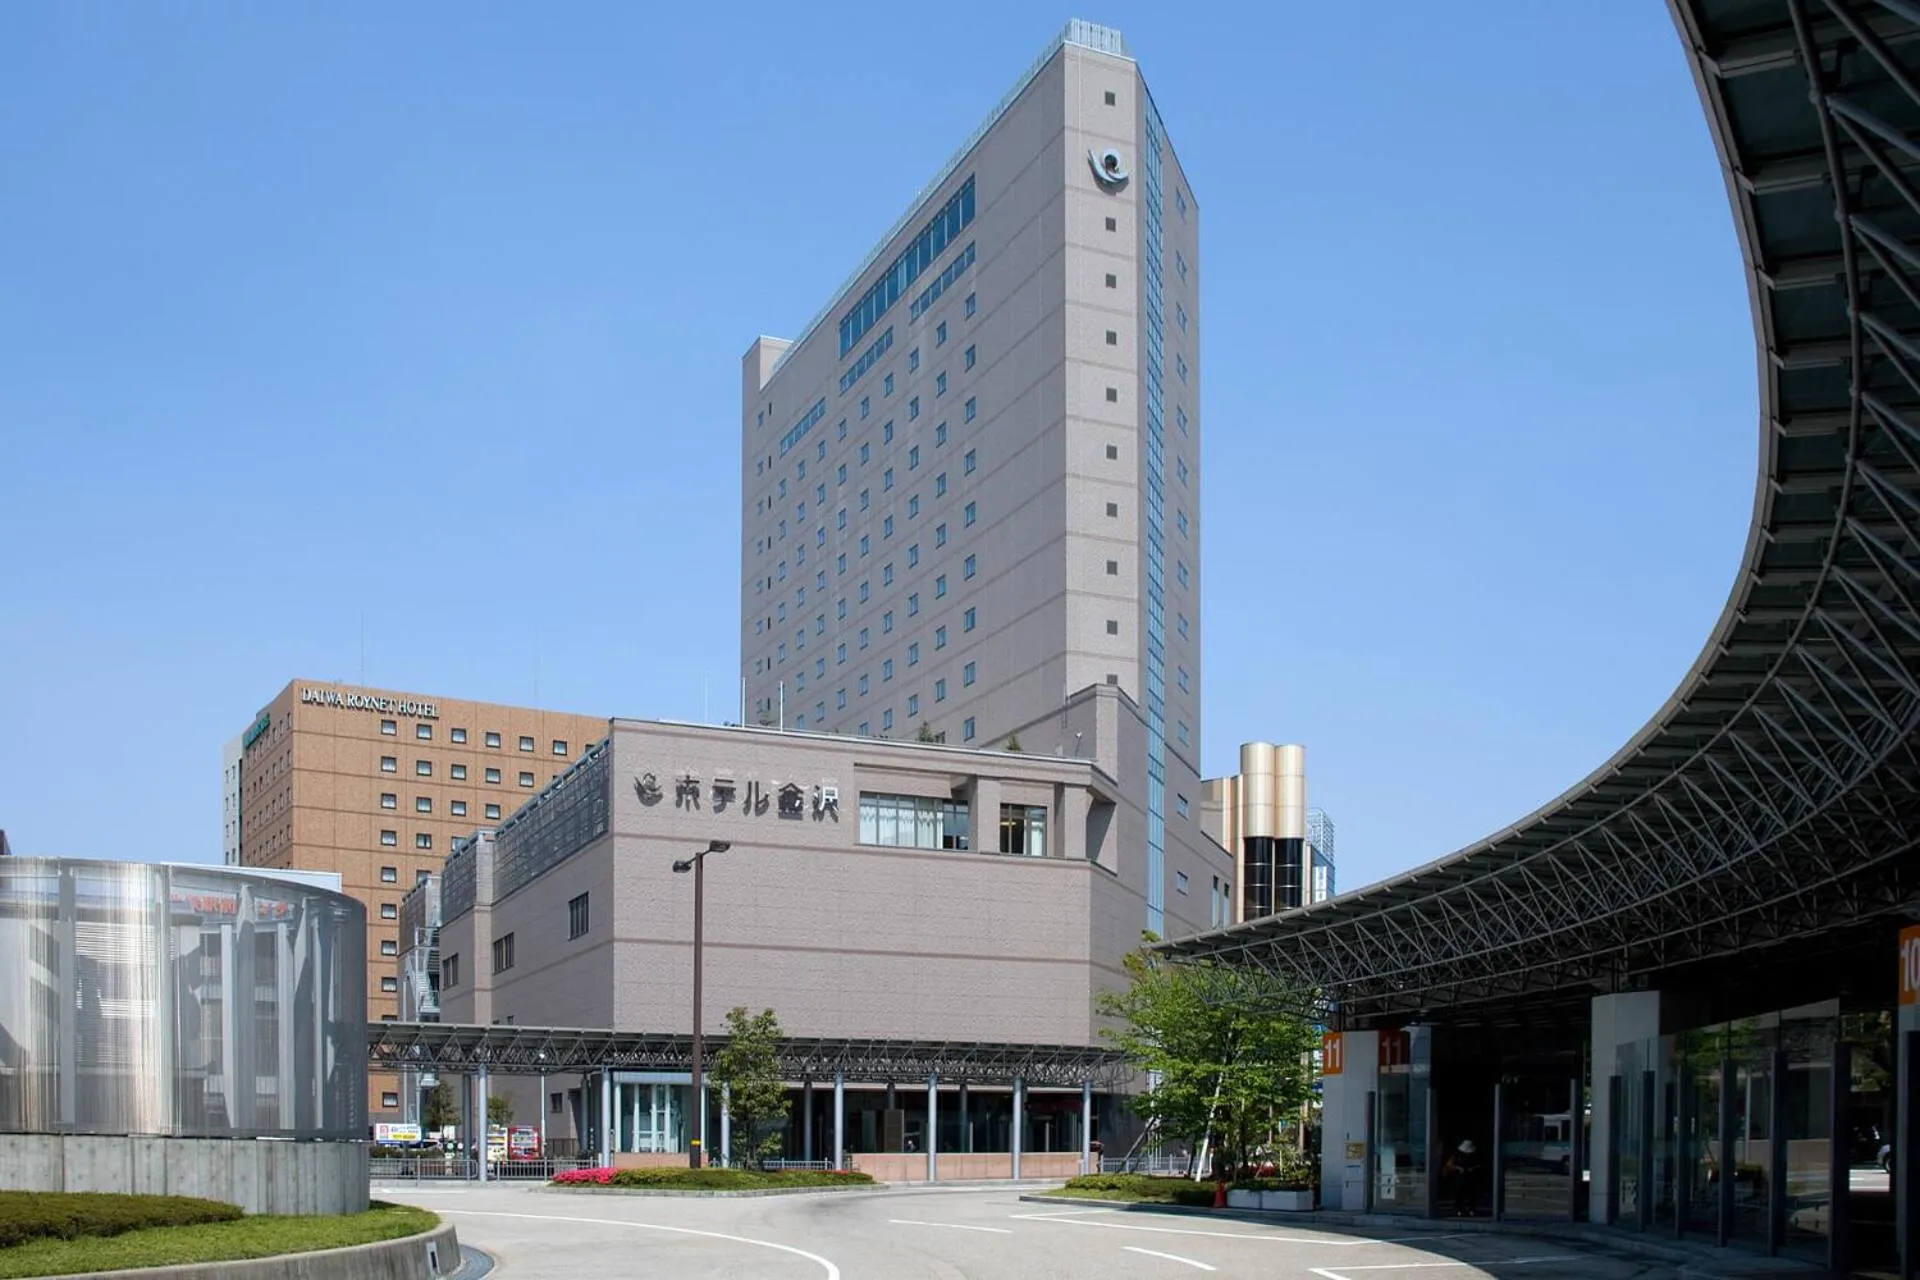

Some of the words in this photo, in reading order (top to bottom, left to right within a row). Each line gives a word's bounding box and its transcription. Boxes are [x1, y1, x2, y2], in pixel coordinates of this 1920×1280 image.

[302, 687, 344, 706] DAIWA
[346, 693, 395, 713] ROYNET
[397, 699, 440, 719] HOTEL
[675, 770, 839, 823] ホテル金沢
[1901, 937, 1920, 992] 10
[1325, 1039, 1340, 1069] 11
[1381, 1036, 1401, 1066] 11
